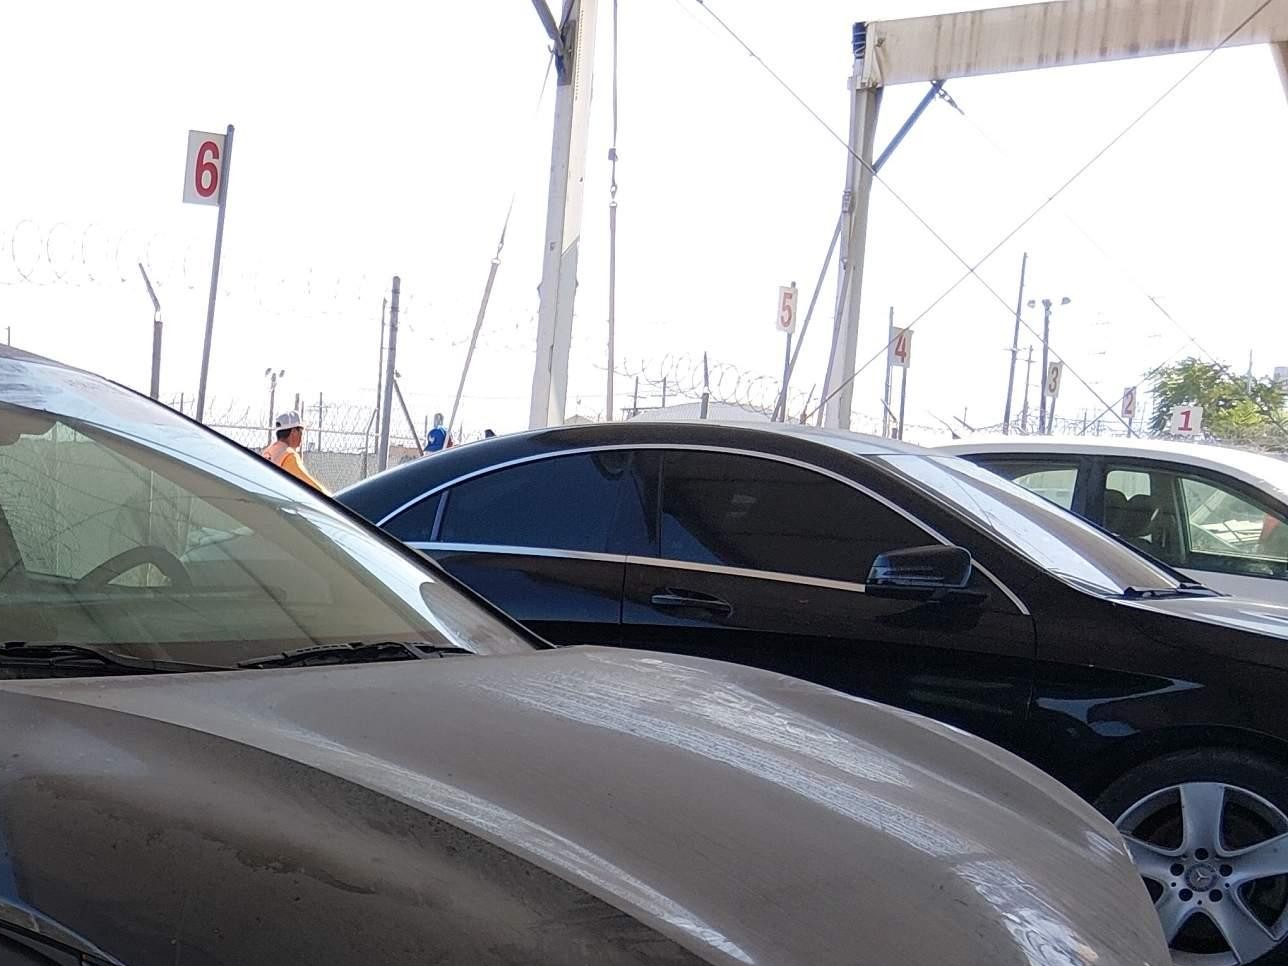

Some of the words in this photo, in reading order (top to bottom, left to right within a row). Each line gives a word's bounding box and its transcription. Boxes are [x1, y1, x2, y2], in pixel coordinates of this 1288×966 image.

[194, 139, 220, 198] 6
[780, 292, 793, 328] 5
[894, 334, 907, 364] 4
[1048, 366, 1059, 394] 3
[1124, 390, 1134, 415] 2
[1177, 410, 1193, 431] 1
